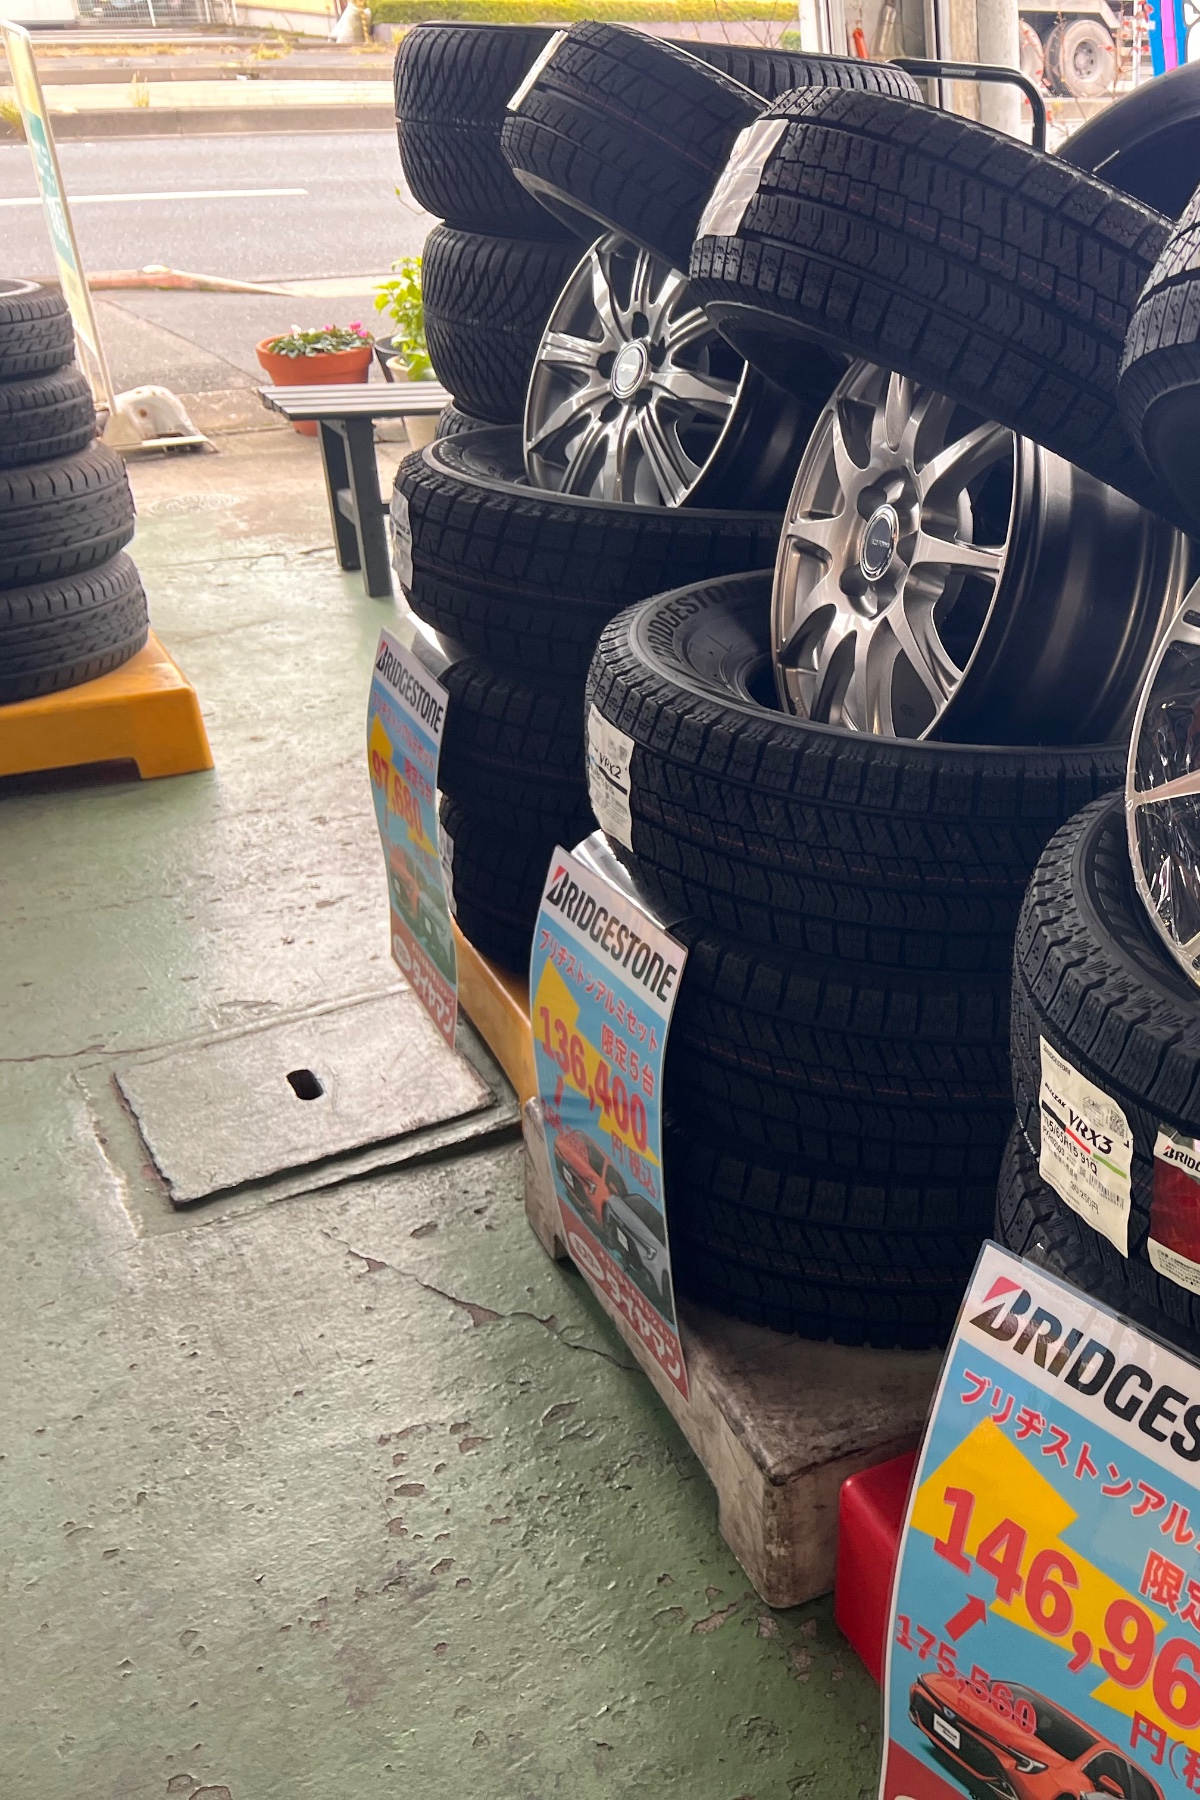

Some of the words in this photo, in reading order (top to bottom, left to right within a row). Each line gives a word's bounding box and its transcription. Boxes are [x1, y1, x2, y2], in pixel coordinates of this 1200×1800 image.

[376, 640, 444, 734] BRIDGESTONE
[546, 864, 679, 1003] BRIDGESTONE
[539, 1005, 649, 1153] 136,400
[1068, 1107, 1114, 1155] VRX3
[606, 1268, 682, 1380] タイヤマン
[895, 1614, 1038, 1736] 175,560
